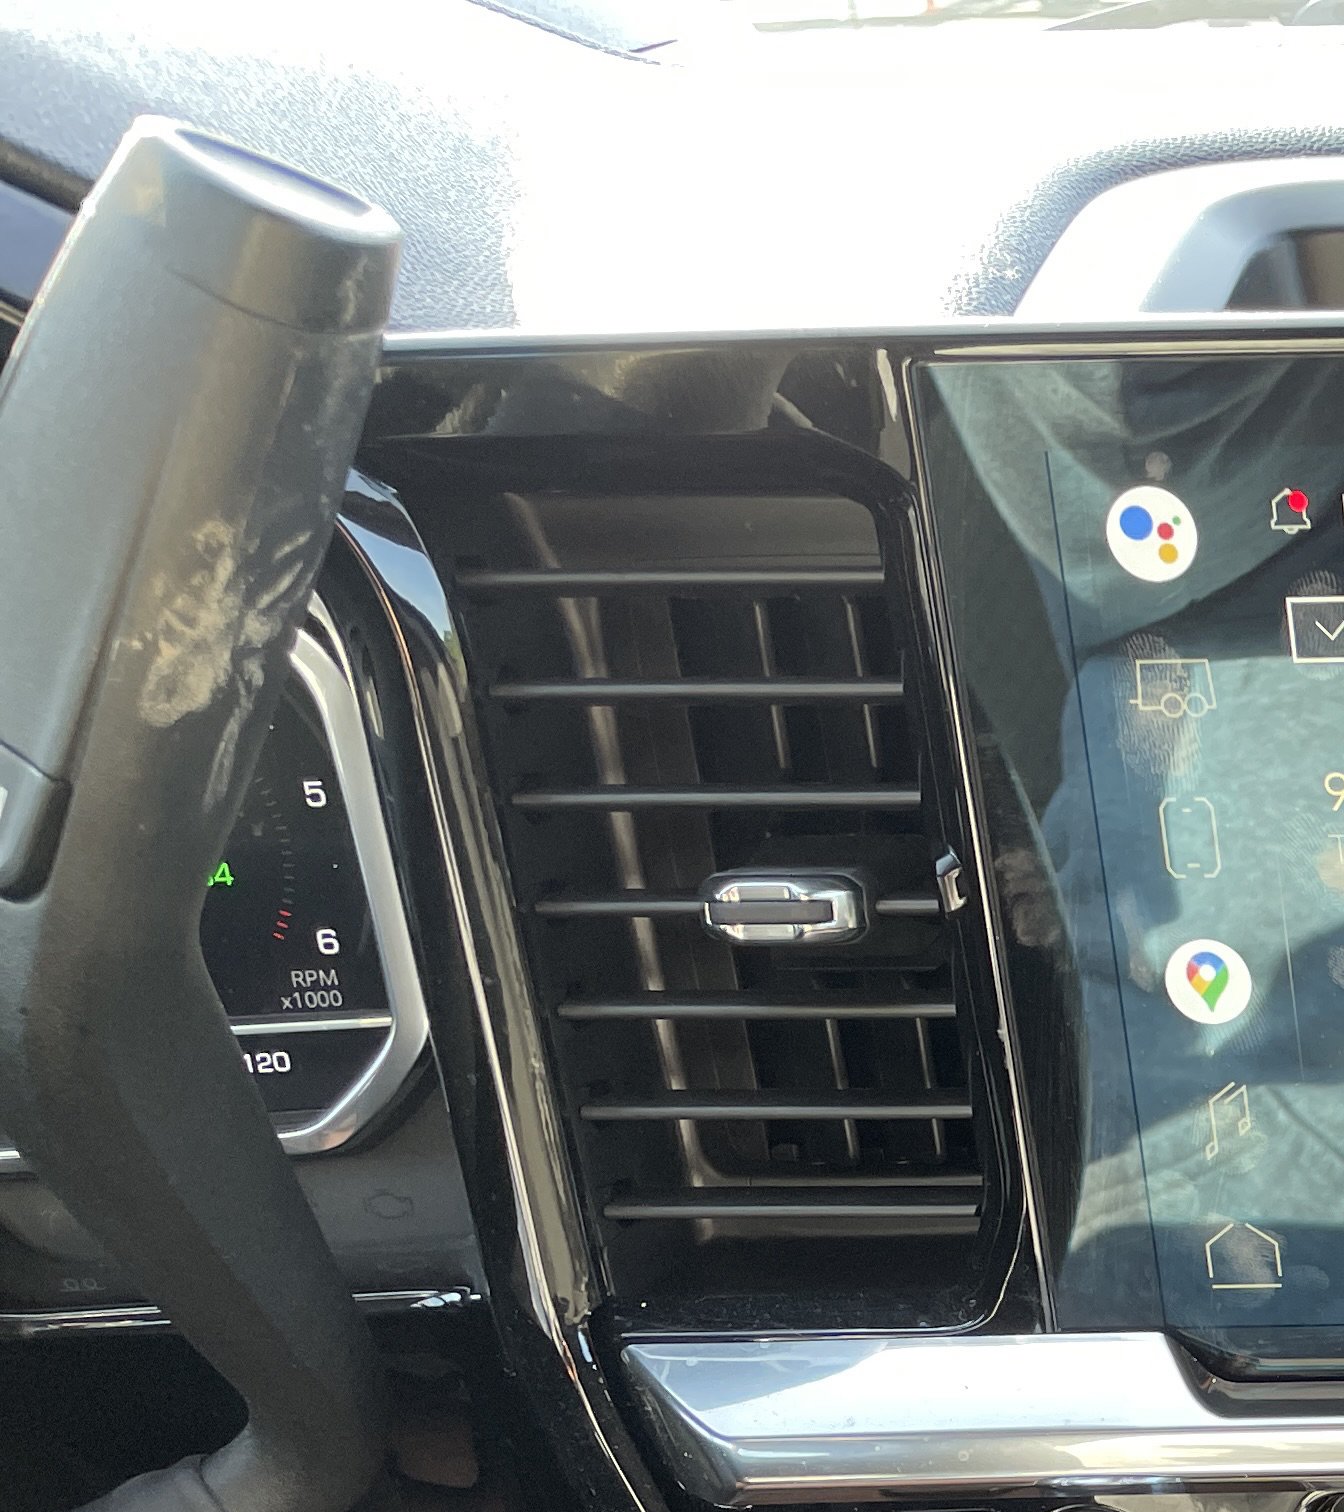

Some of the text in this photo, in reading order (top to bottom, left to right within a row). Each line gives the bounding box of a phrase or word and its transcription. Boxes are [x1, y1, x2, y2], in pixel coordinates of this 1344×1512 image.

[302, 779, 328, 808] 5
[316, 929, 340, 955] 6
[290, 969, 338, 988] RPM
[280, 990, 343, 1010] x1000
[243, 1051, 292, 1074] 120
